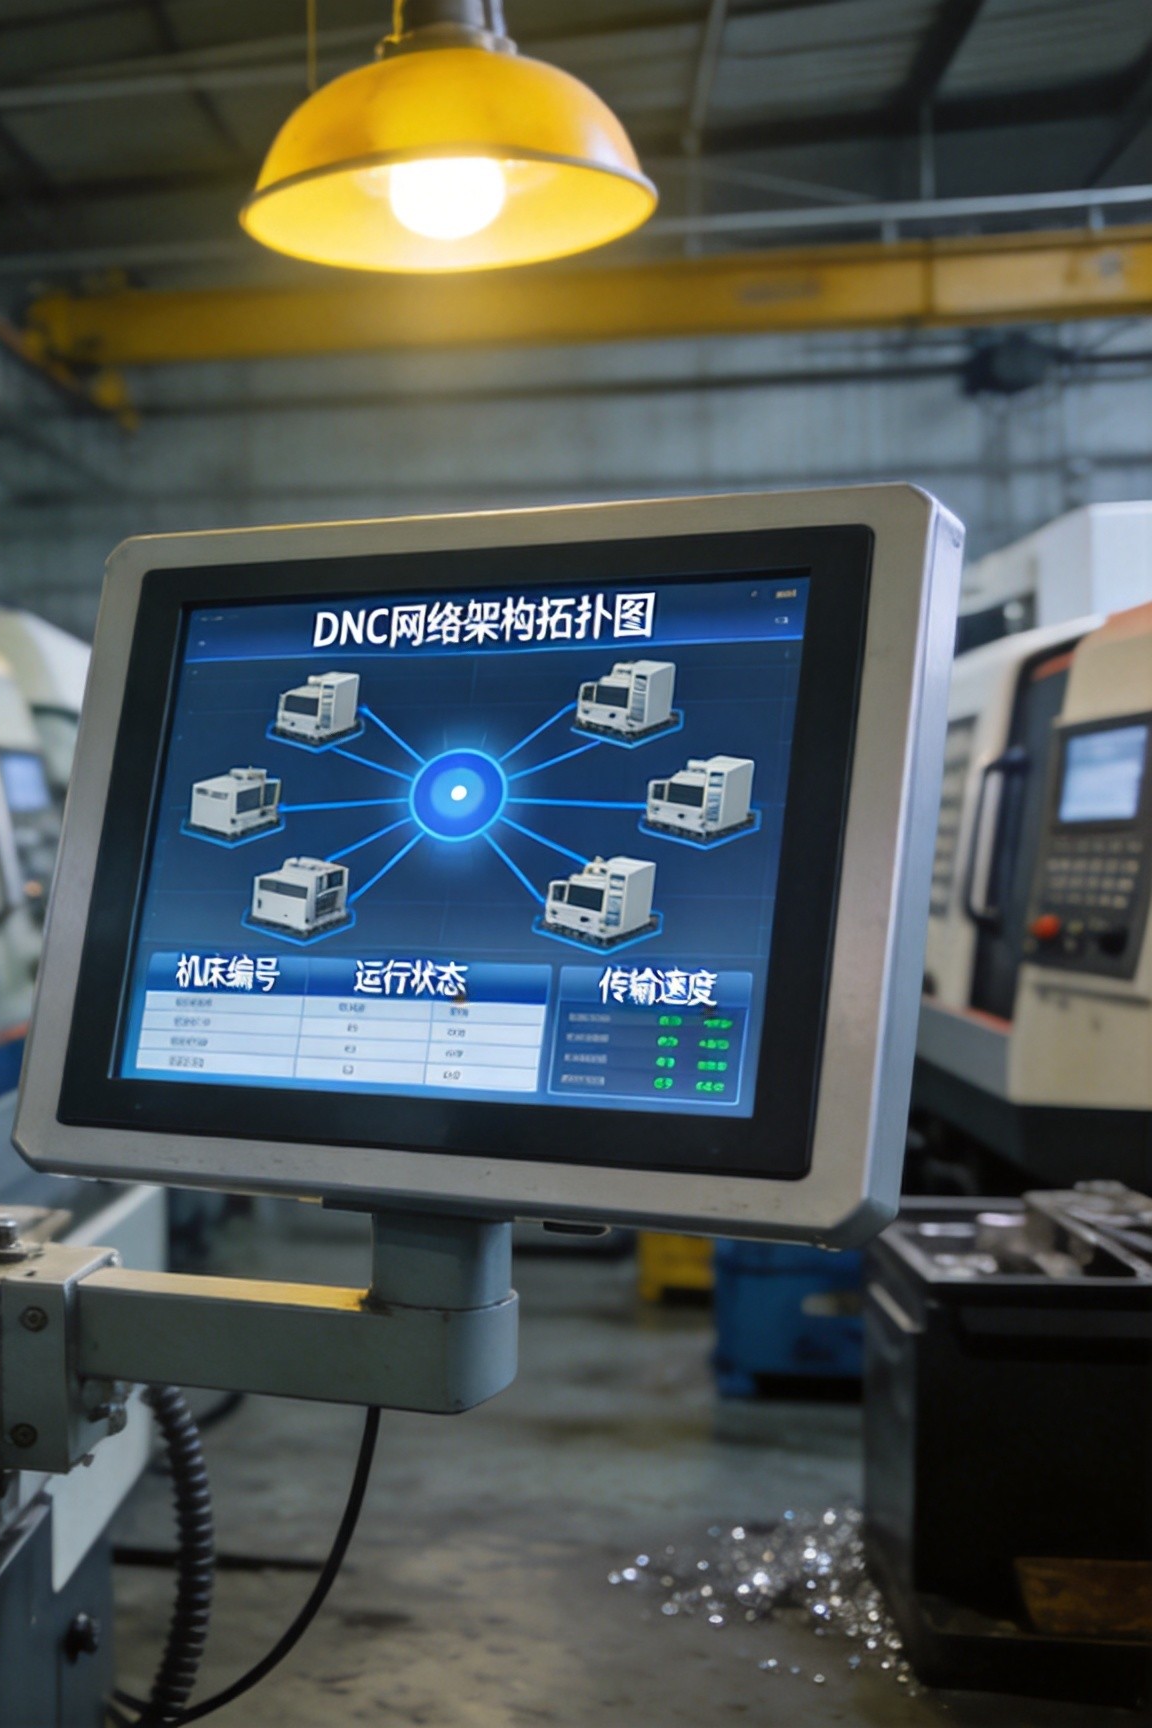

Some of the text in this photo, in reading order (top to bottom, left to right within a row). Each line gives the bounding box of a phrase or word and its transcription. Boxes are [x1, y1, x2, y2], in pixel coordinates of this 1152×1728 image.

[175, 953, 280, 992] 机床编号
[354, 959, 468, 997] 运行状态
